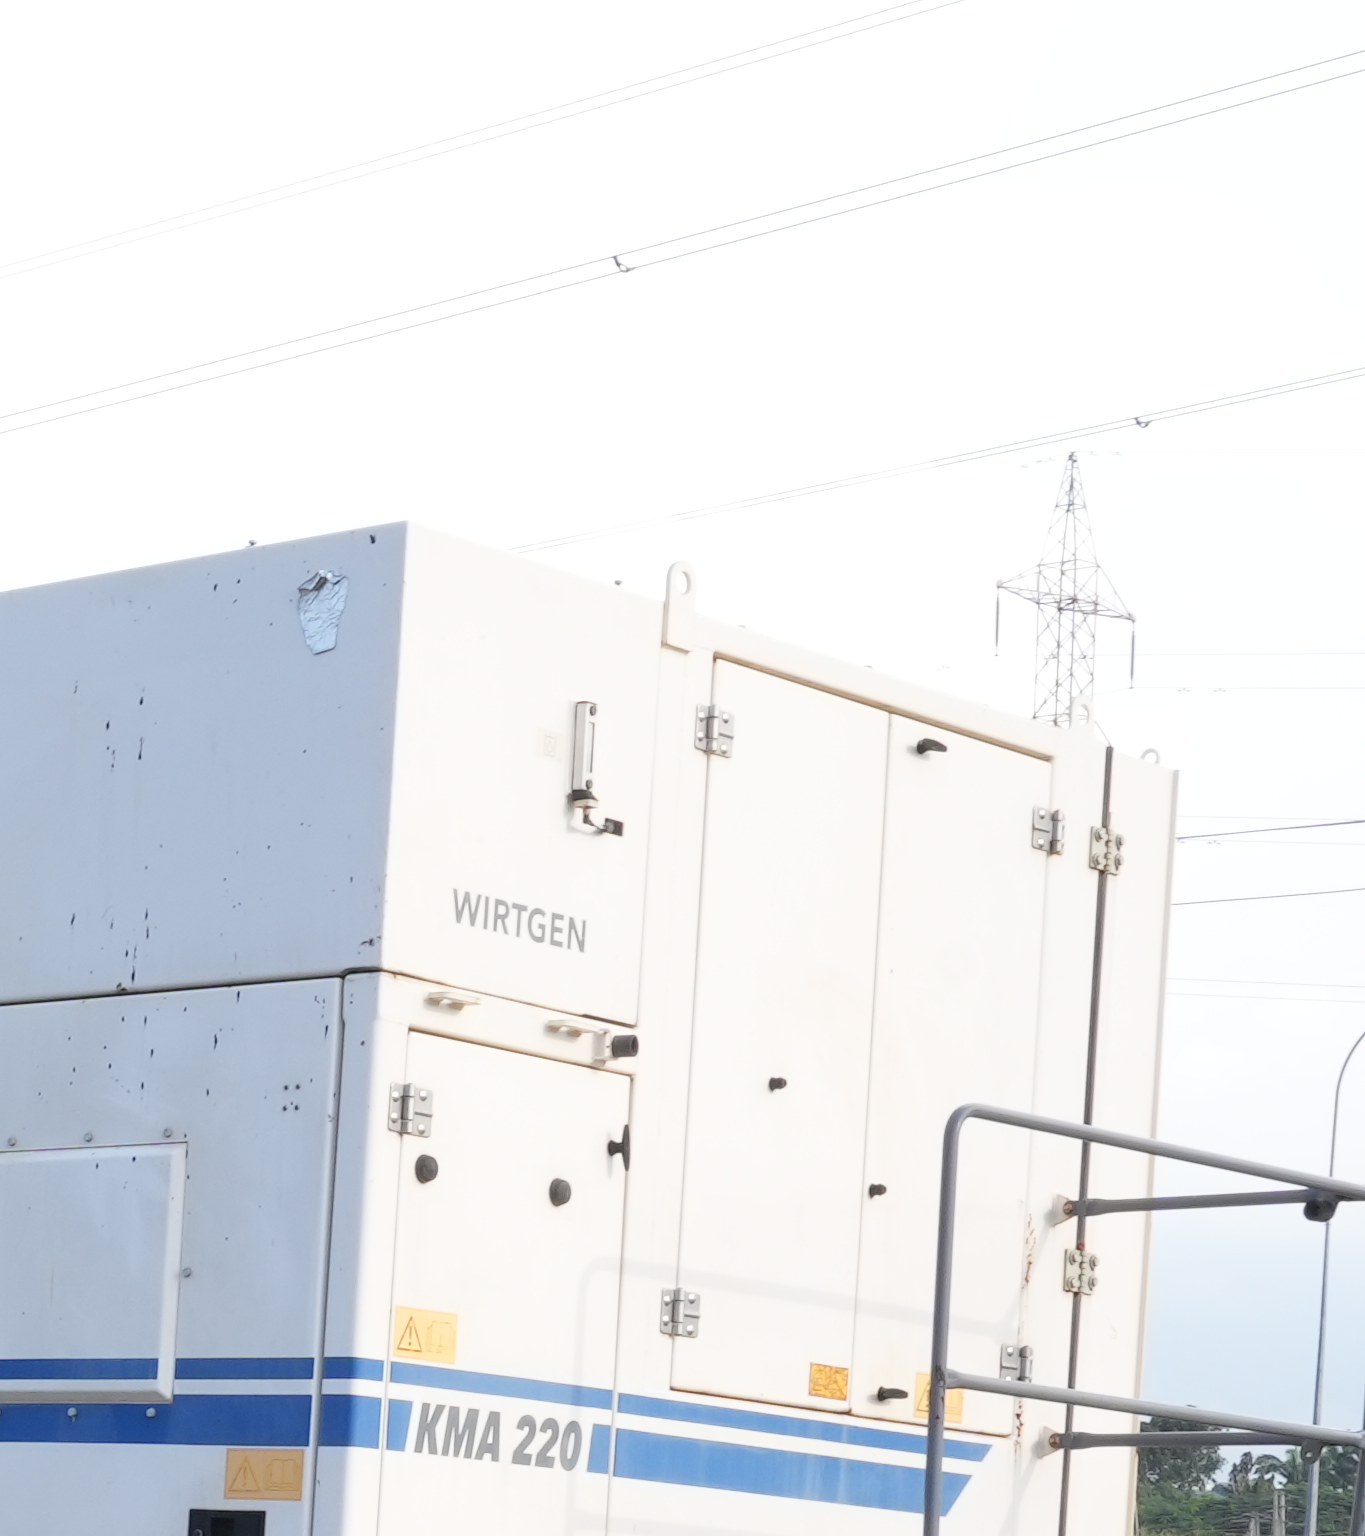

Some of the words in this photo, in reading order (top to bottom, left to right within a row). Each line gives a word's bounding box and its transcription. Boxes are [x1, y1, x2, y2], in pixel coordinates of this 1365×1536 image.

[453, 888, 586, 953] WIRTGEN
[413, 1402, 501, 1463] KMA
[511, 1414, 583, 1472] 220
